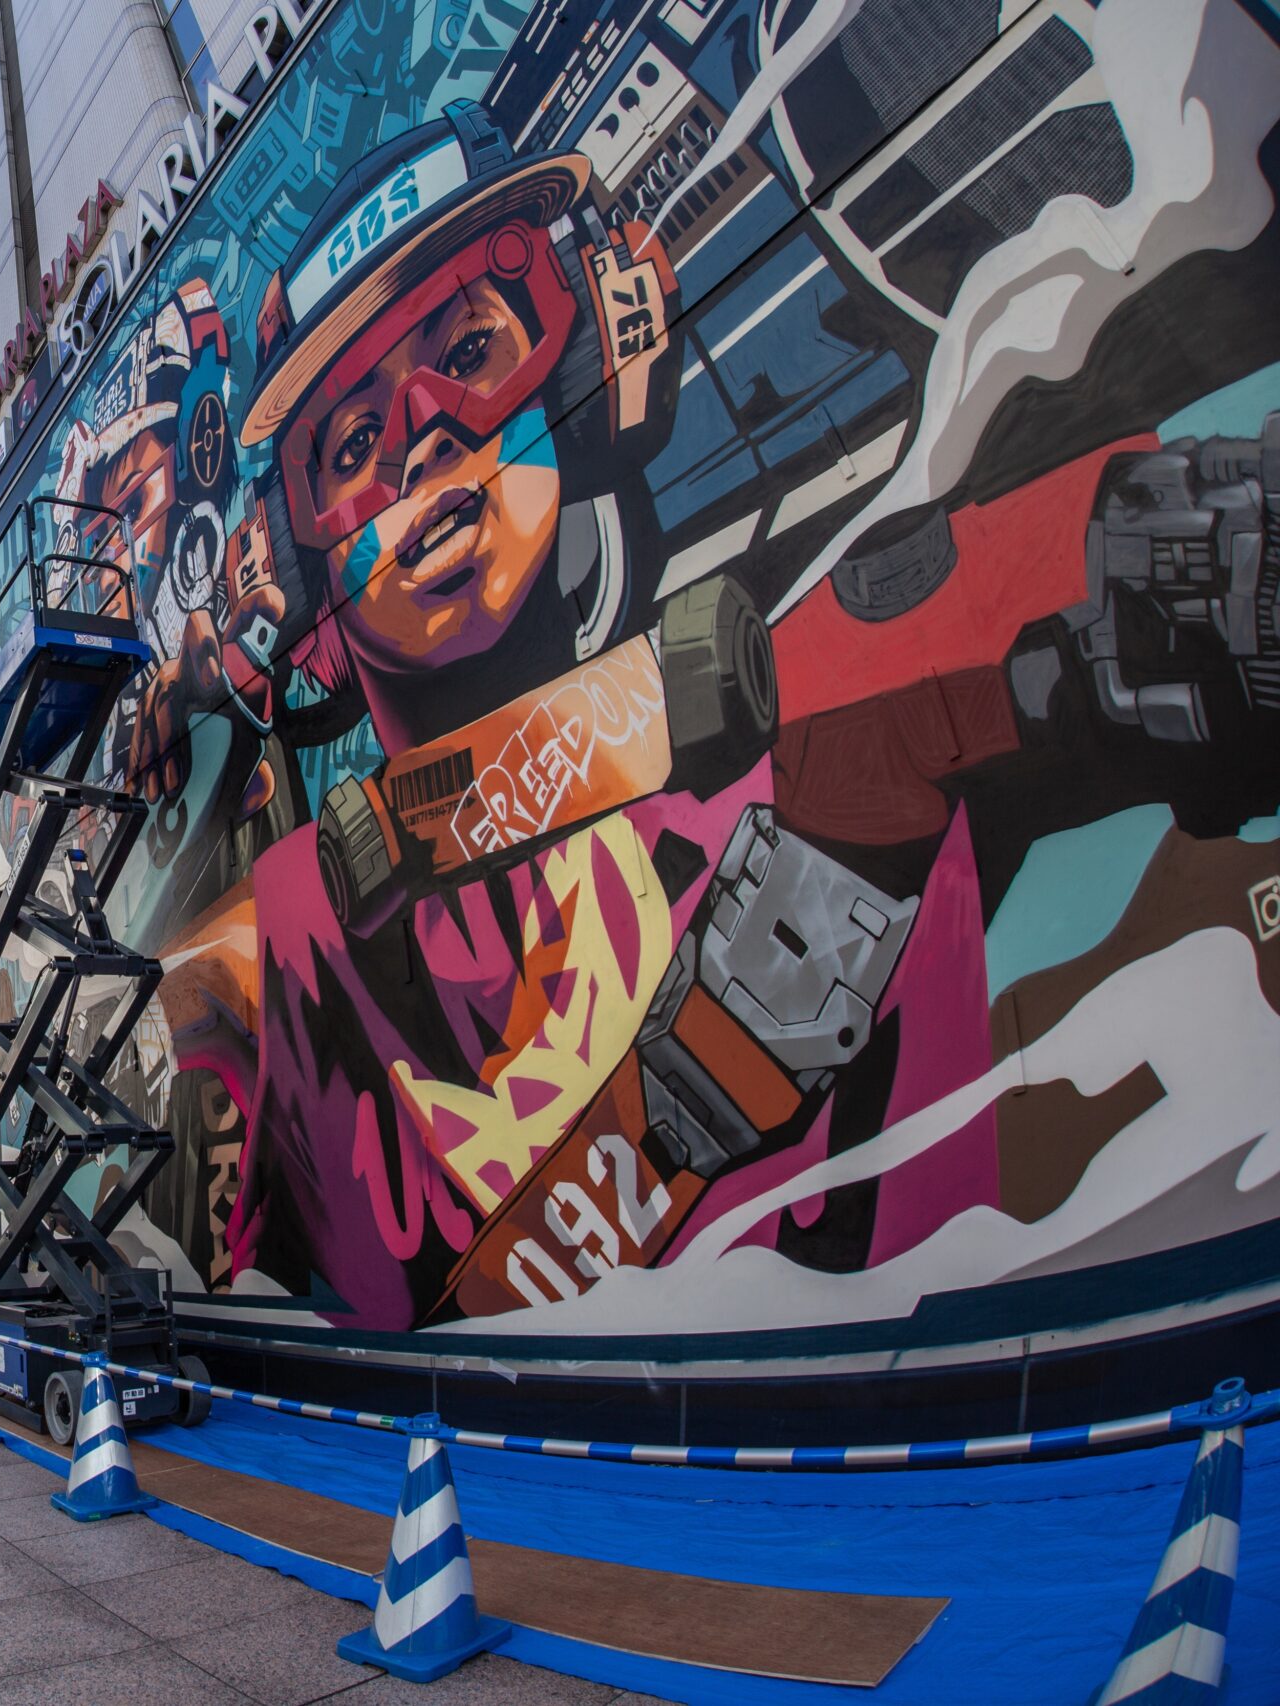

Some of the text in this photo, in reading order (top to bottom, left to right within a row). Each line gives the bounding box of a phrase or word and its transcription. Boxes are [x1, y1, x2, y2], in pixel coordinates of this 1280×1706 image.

[38, 177, 124, 323] PLAZA
[58, 80, 252, 388] SOLARIA
[506, 1134, 672, 1308] 092
